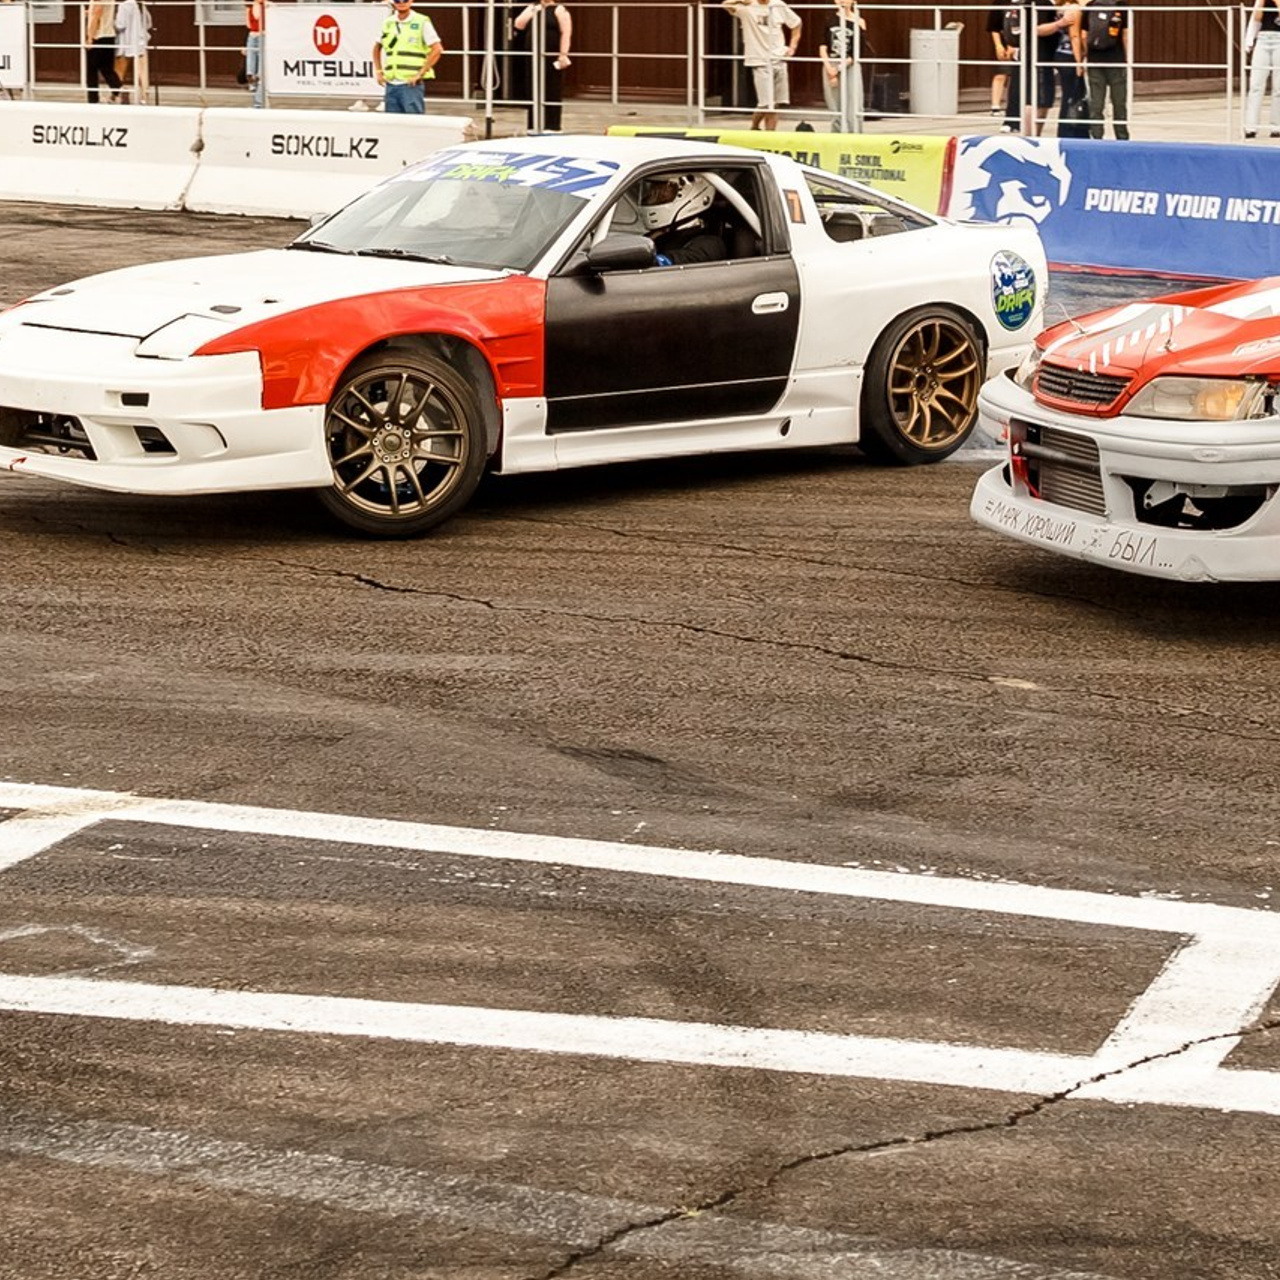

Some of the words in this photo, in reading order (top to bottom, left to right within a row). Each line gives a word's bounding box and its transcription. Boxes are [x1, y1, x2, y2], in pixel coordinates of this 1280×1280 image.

[284, 60, 373, 78] MITSUJI
[33, 125, 128, 148] SOKOL.KZ
[271, 134, 379, 159] SOKOL.KZ
[855, 155, 882, 168] SOKOL
[1084, 188, 1160, 216] POWER
[1165, 192, 1223, 219] YOUR
